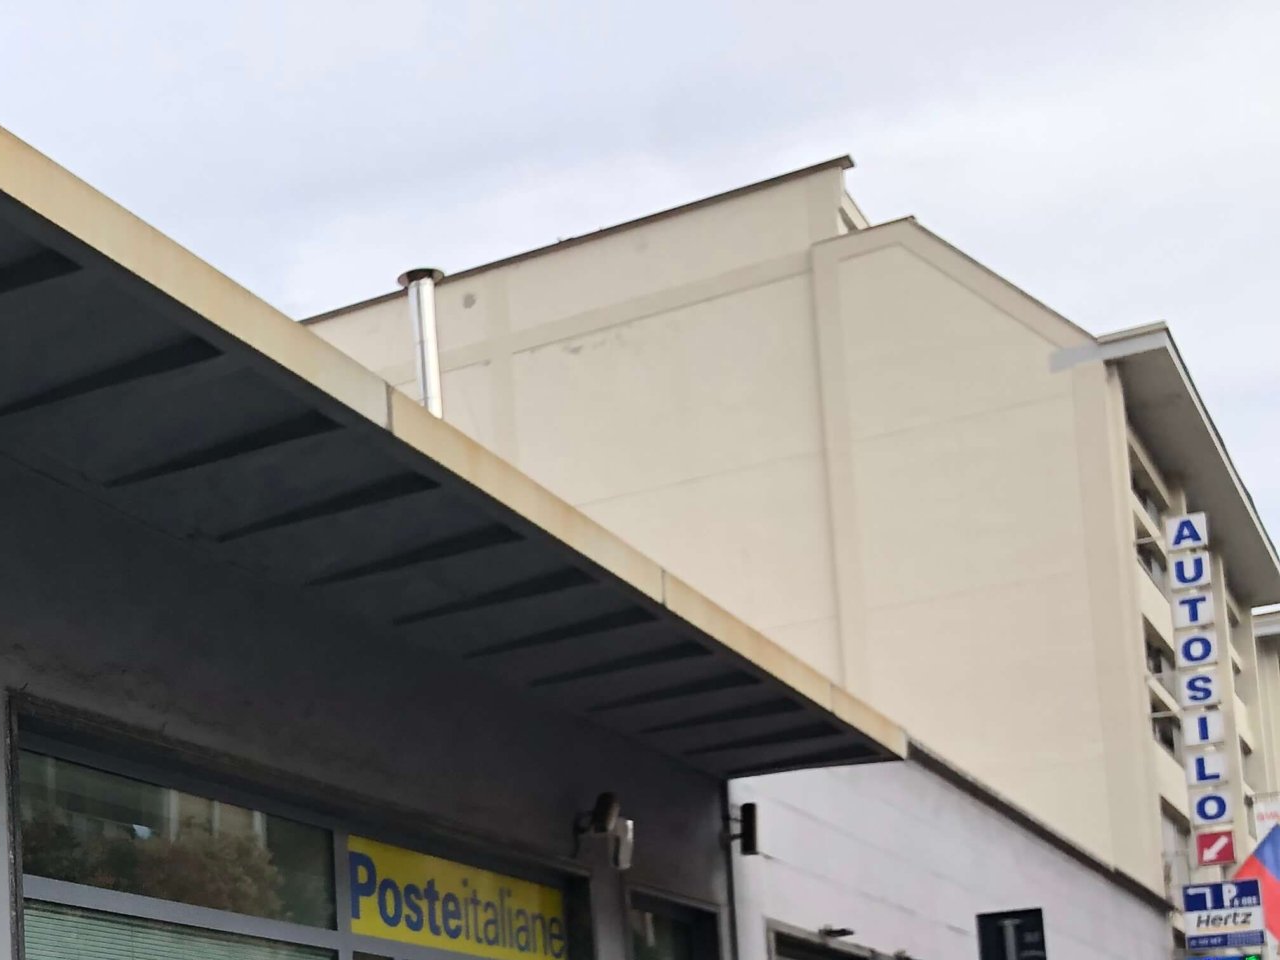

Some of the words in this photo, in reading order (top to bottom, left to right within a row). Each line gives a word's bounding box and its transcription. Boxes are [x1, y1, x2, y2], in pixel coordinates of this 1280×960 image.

[1172, 518, 1227, 822] AUTOSILO
[348, 851, 568, 959] Posteitaliane
[1196, 911, 1253, 928] Hertz
